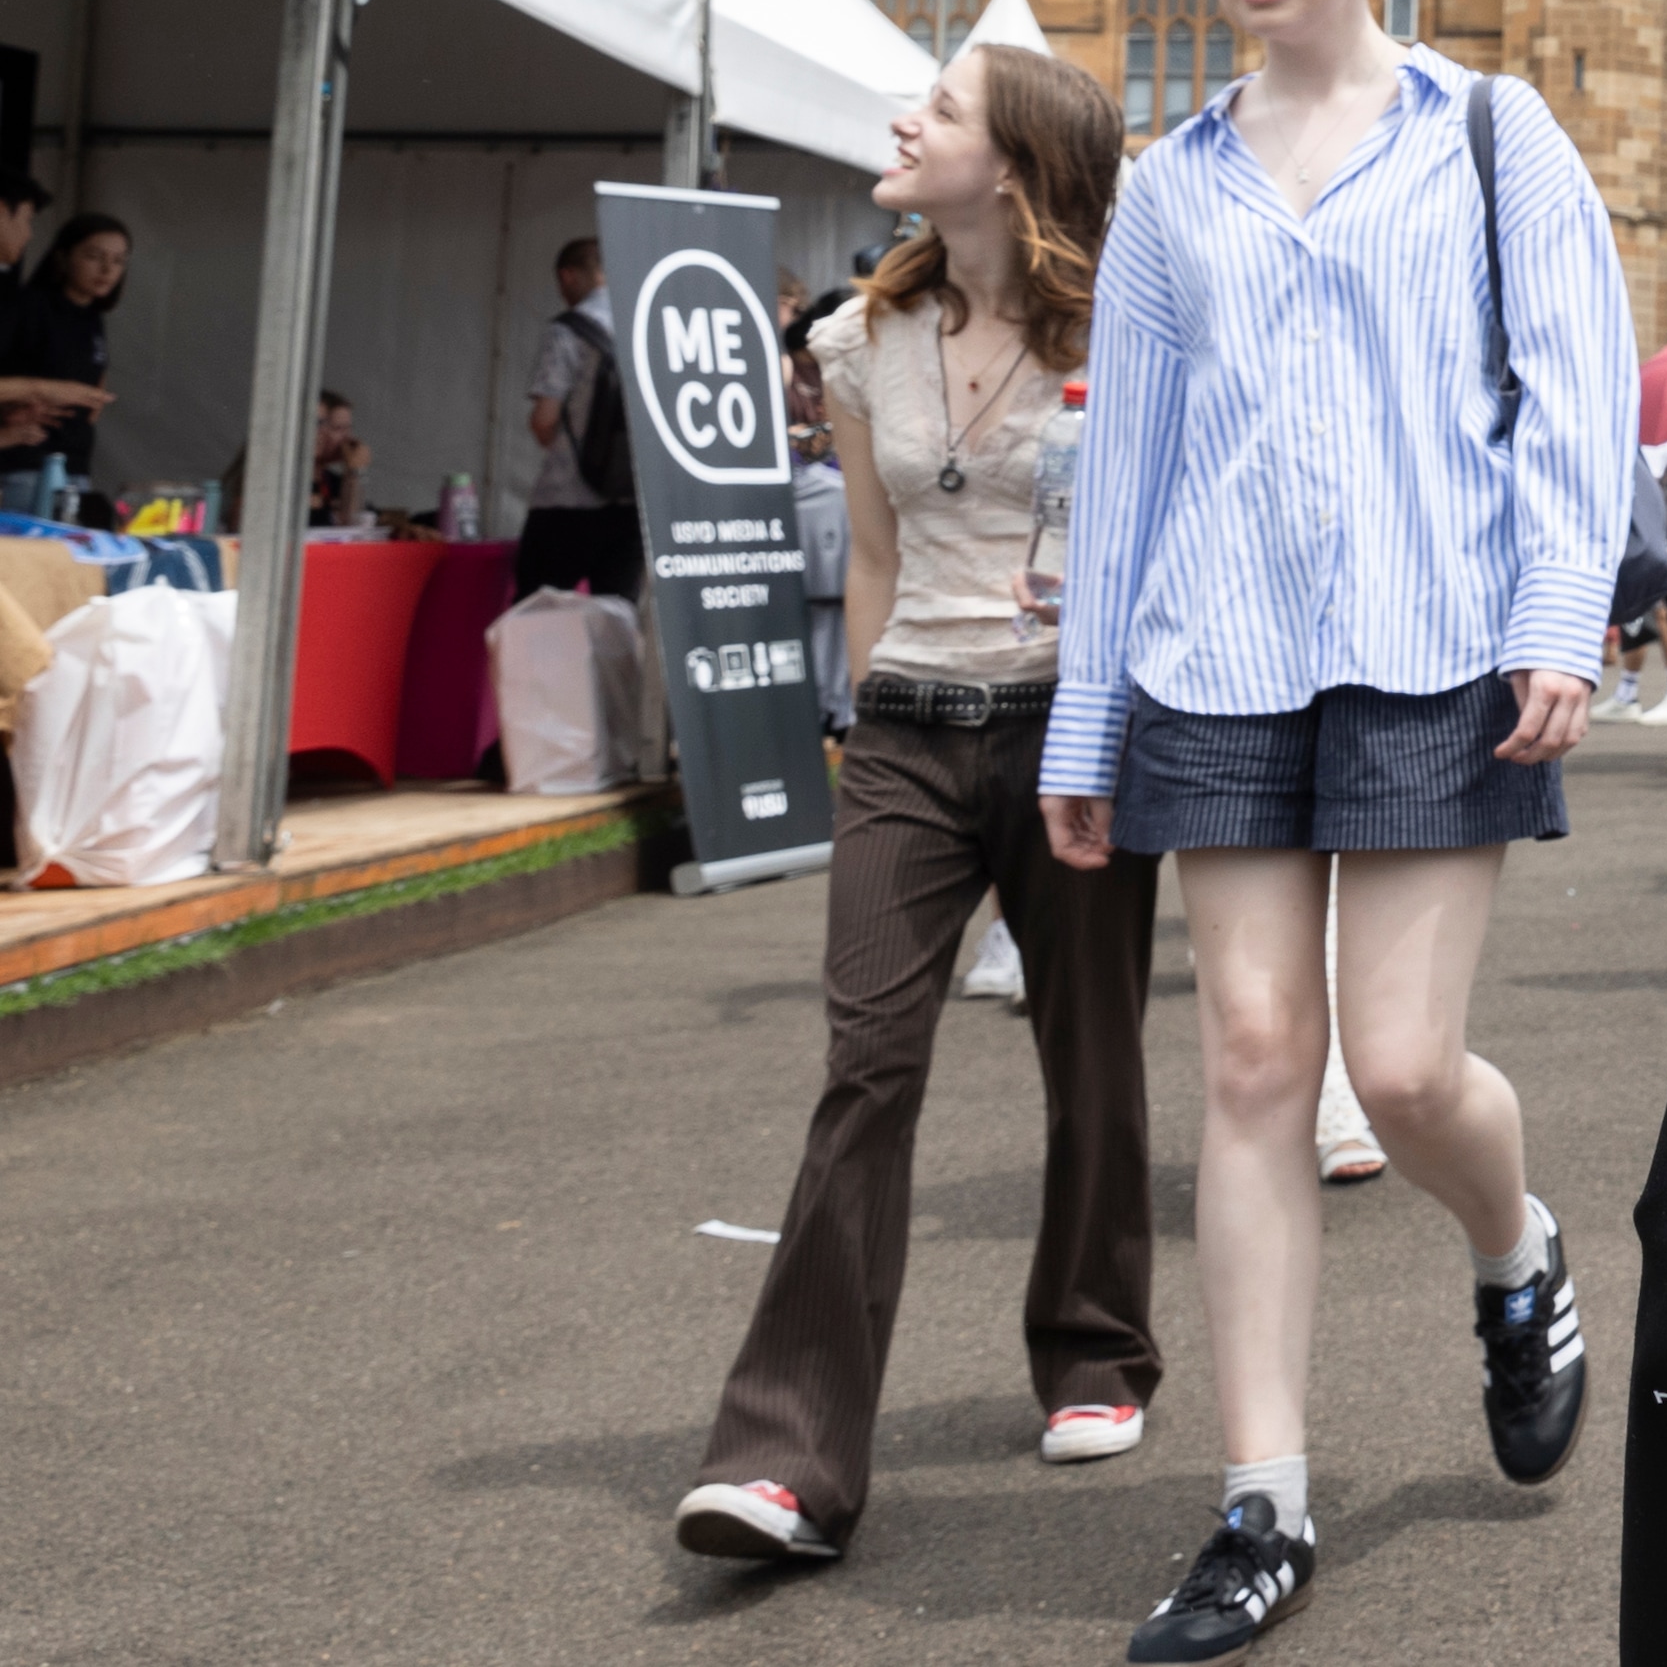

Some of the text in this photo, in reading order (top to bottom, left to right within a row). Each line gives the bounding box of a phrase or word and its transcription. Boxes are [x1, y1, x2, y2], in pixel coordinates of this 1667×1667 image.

[662, 305, 747, 375] ME
[676, 380, 756, 449] CO
[655, 549, 806, 579] COMMUNICATIONS
